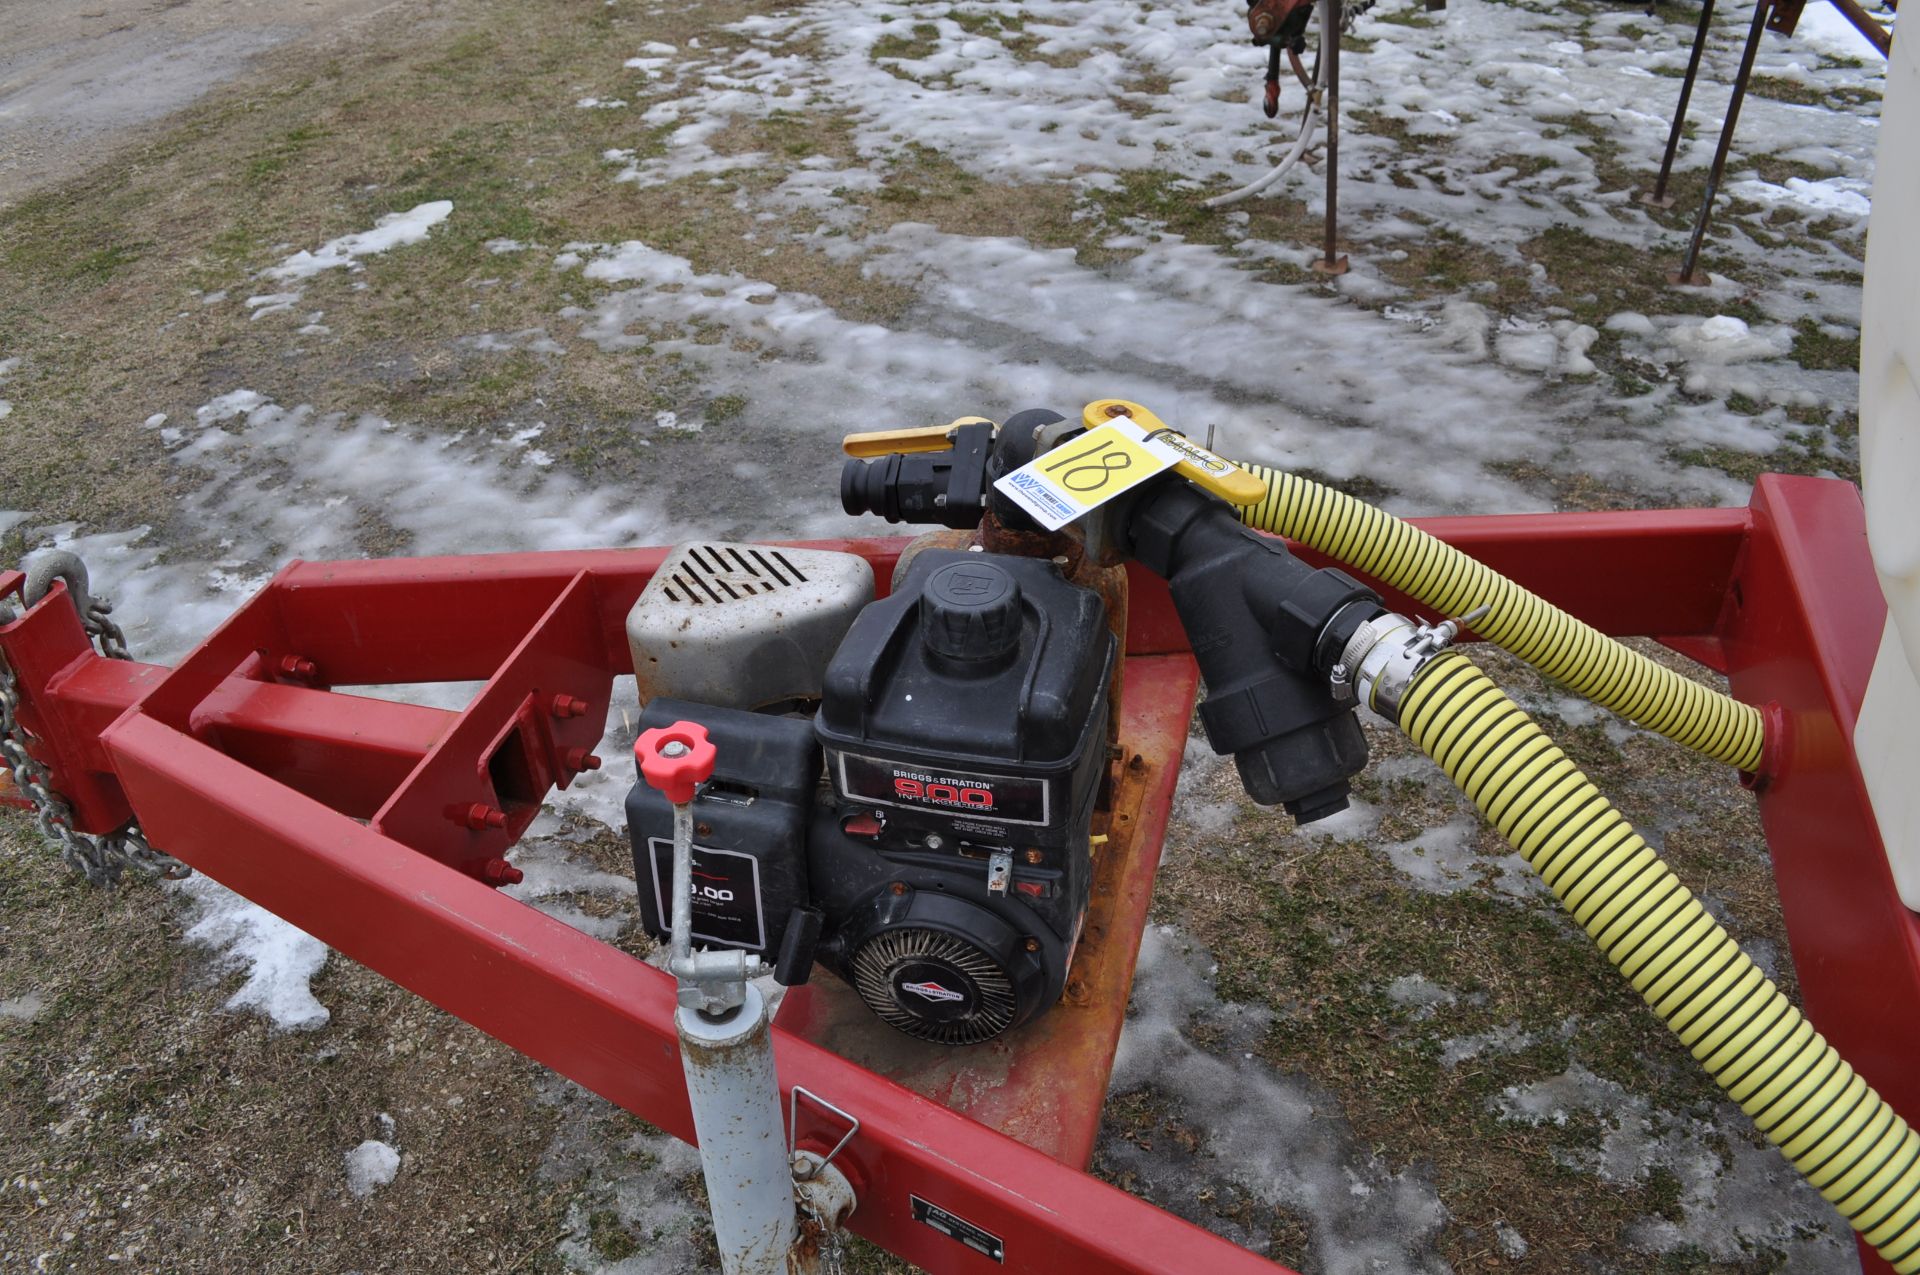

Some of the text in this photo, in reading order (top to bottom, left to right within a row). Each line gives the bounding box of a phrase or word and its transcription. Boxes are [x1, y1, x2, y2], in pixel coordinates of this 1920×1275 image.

[1045, 440, 1131, 491] 18
[893, 769, 932, 783] BRIGGS
[940, 777, 990, 789] STRATTON
[895, 778, 993, 806] 900
[905, 984, 928, 993] BRIGGS
